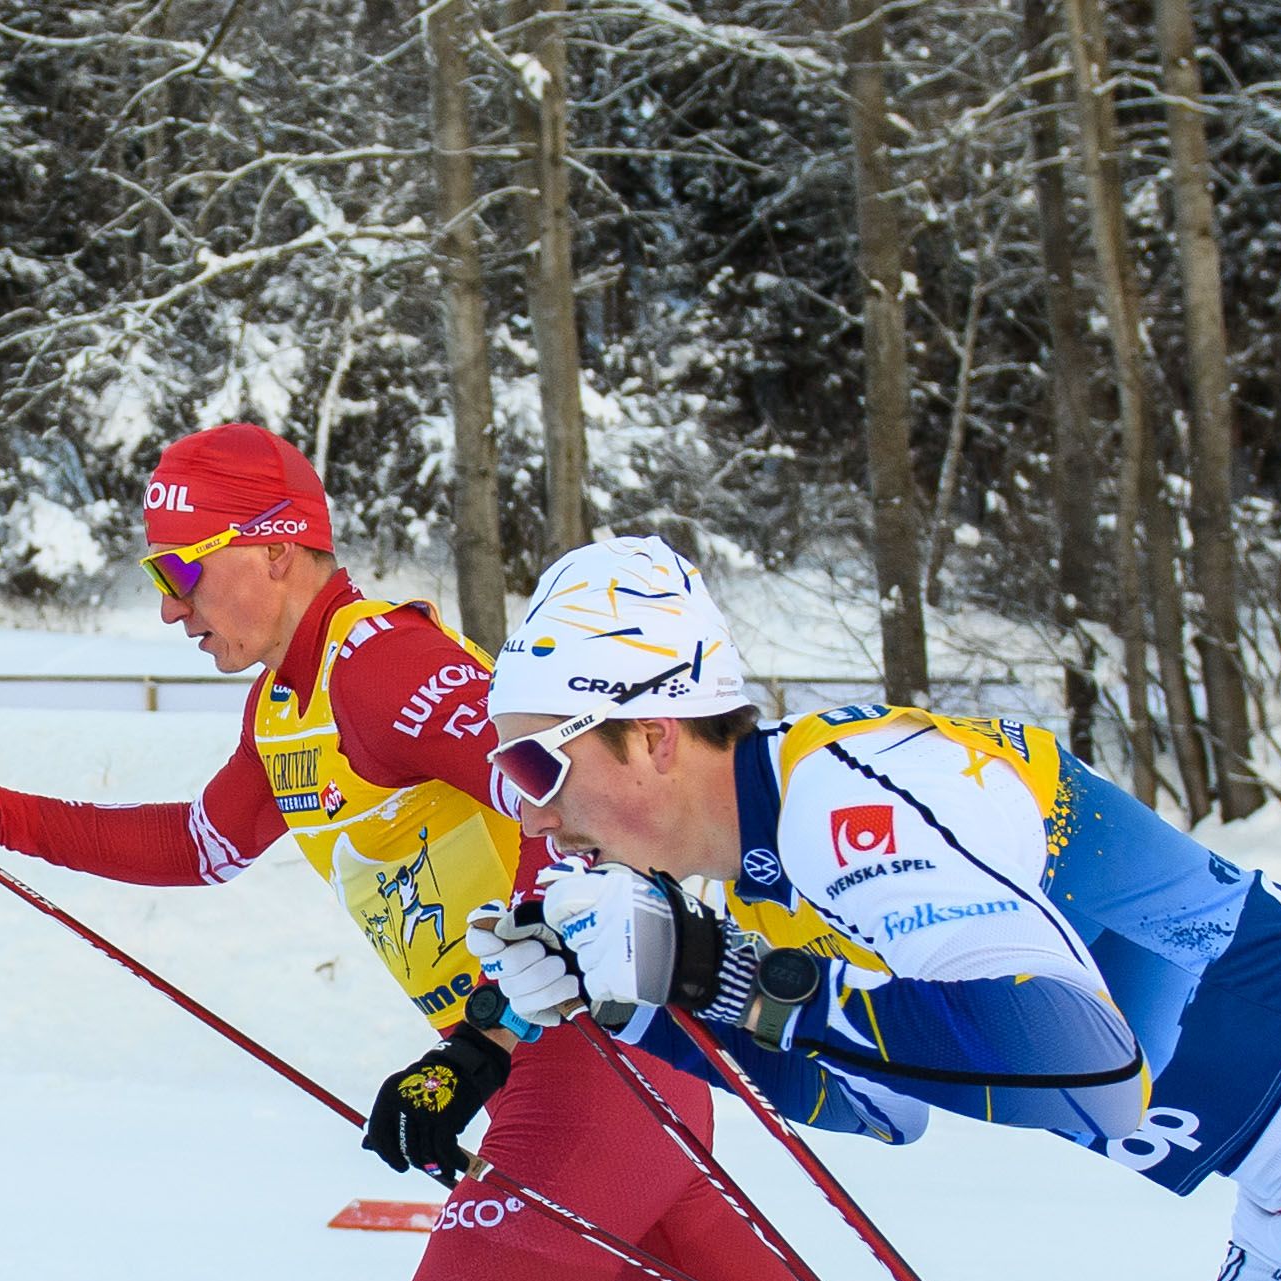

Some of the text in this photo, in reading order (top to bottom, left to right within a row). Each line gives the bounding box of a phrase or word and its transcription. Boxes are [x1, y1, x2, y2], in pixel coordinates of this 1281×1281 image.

[826, 859, 936, 900] SVENSKA SPEL
[882, 899, 1019, 943] Folksam
